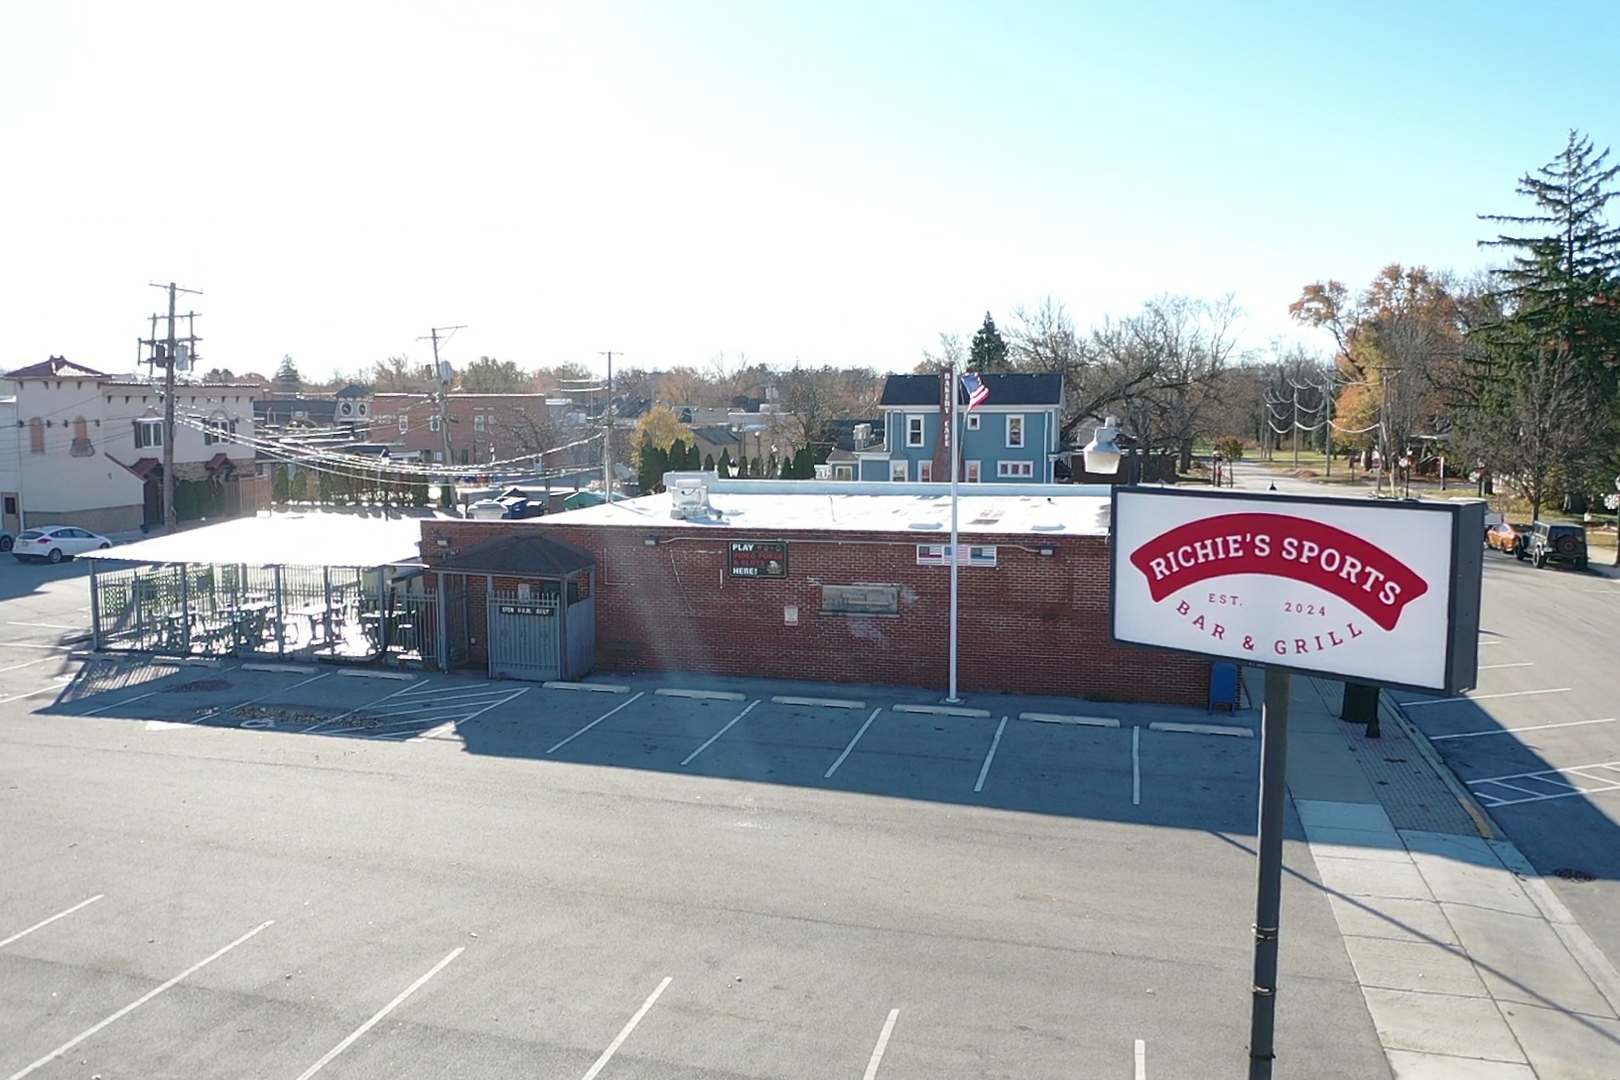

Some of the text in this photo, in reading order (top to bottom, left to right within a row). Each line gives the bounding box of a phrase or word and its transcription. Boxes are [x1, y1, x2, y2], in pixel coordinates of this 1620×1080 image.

[732, 543, 754, 551] PLAY
[732, 567, 758, 575] HERE!
[1149, 533, 1402, 606] RICHIE'S SPORTS
[1208, 593, 1326, 617] EST. 2024
[1176, 600, 1363, 655] BAR & GRILL
